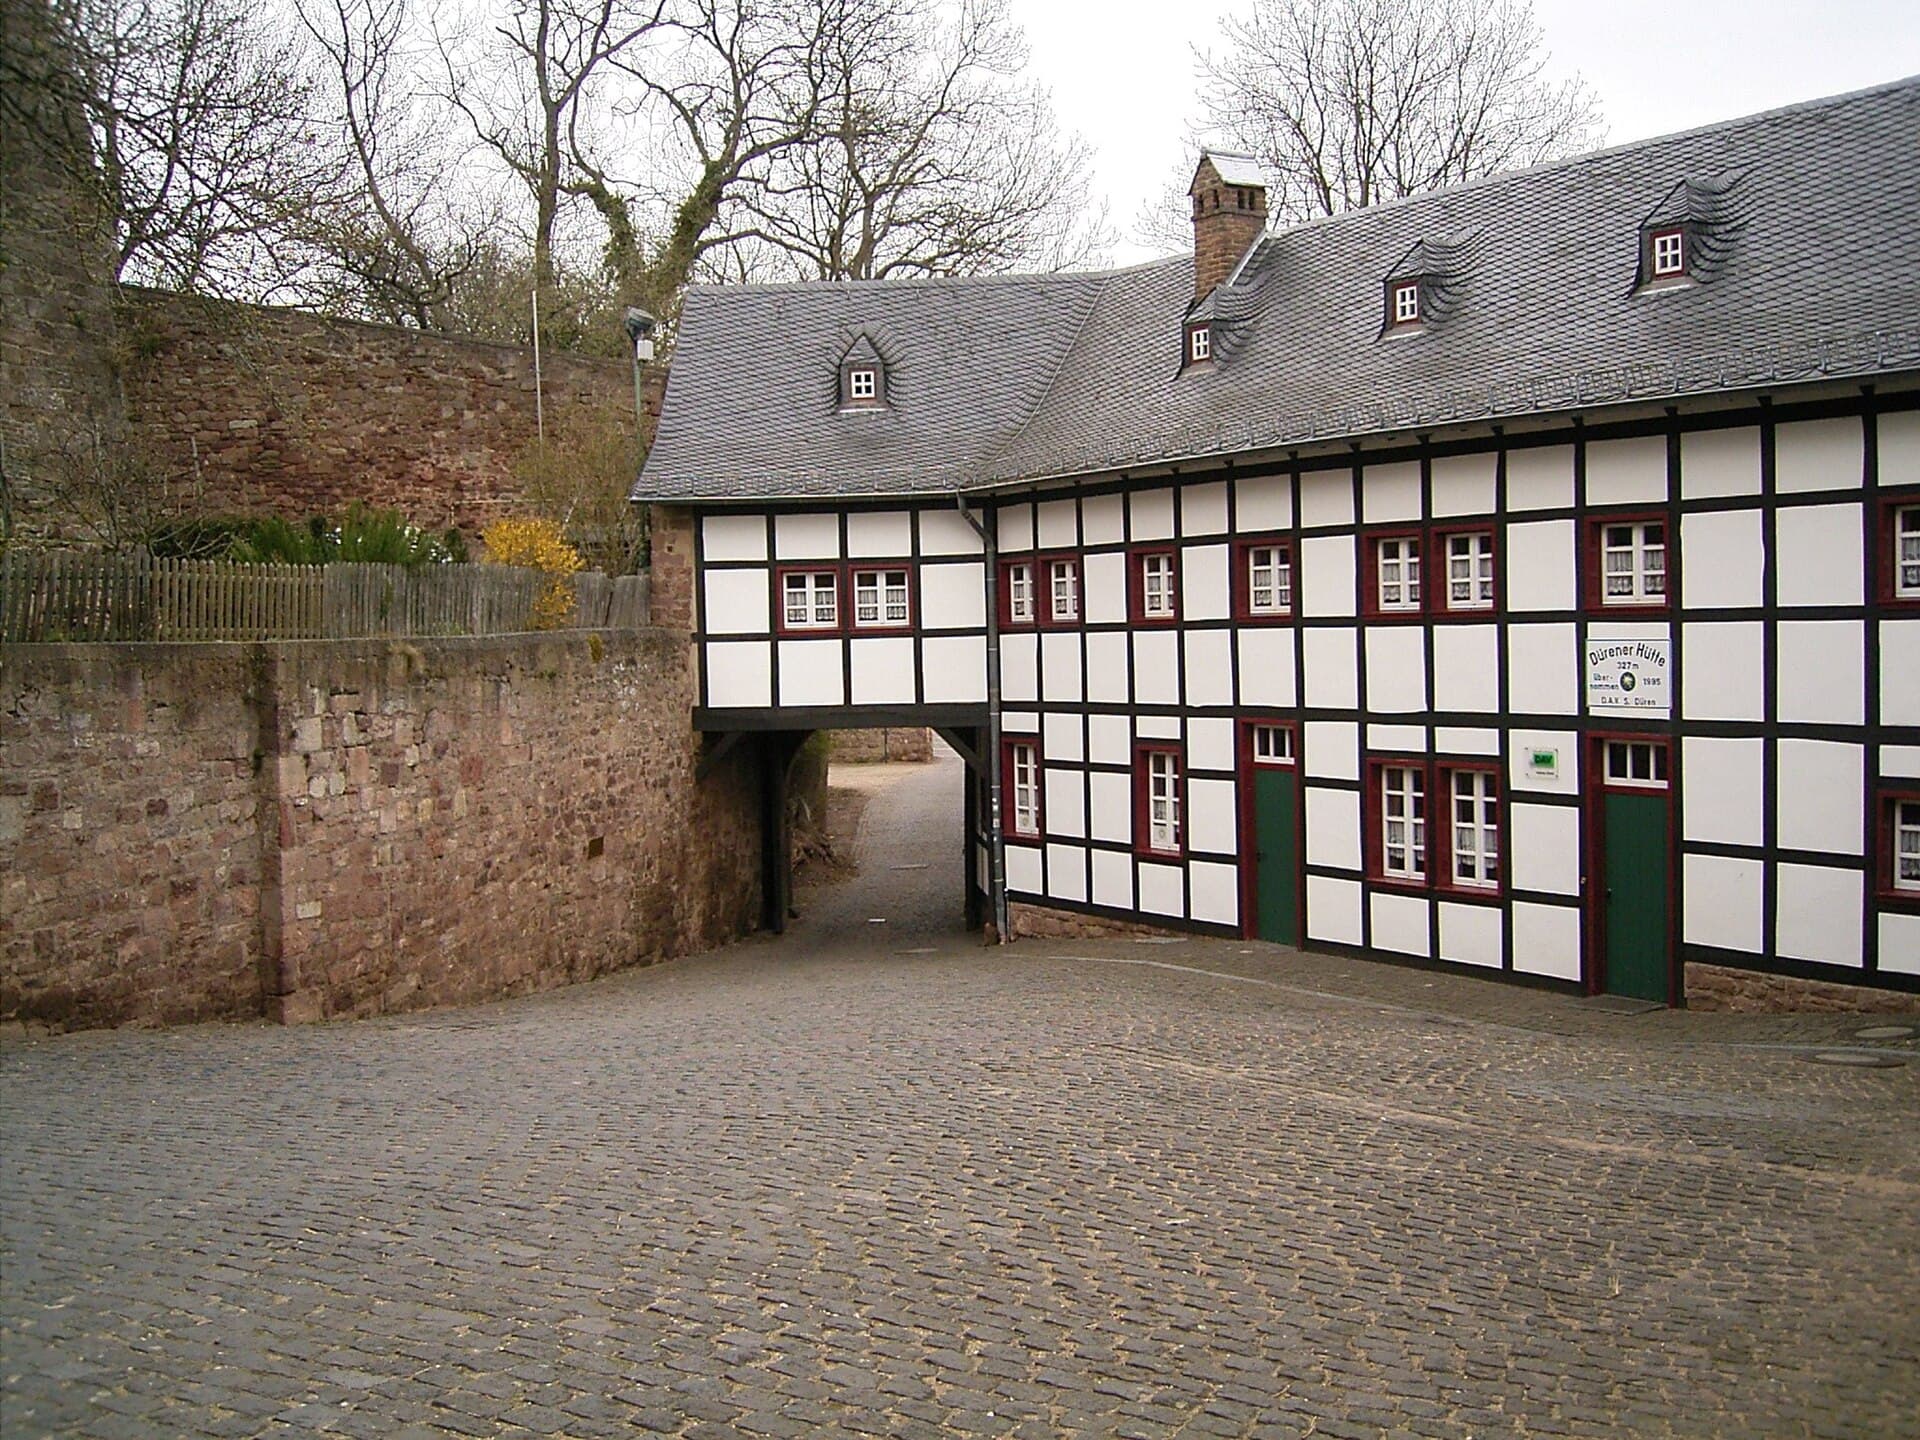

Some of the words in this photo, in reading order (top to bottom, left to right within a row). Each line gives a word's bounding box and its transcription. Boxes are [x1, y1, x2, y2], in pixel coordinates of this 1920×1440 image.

[1589, 645, 1634, 666] Dürener
[1636, 642, 1666, 667] Hütte
[1634, 696, 1656, 706] Düren
